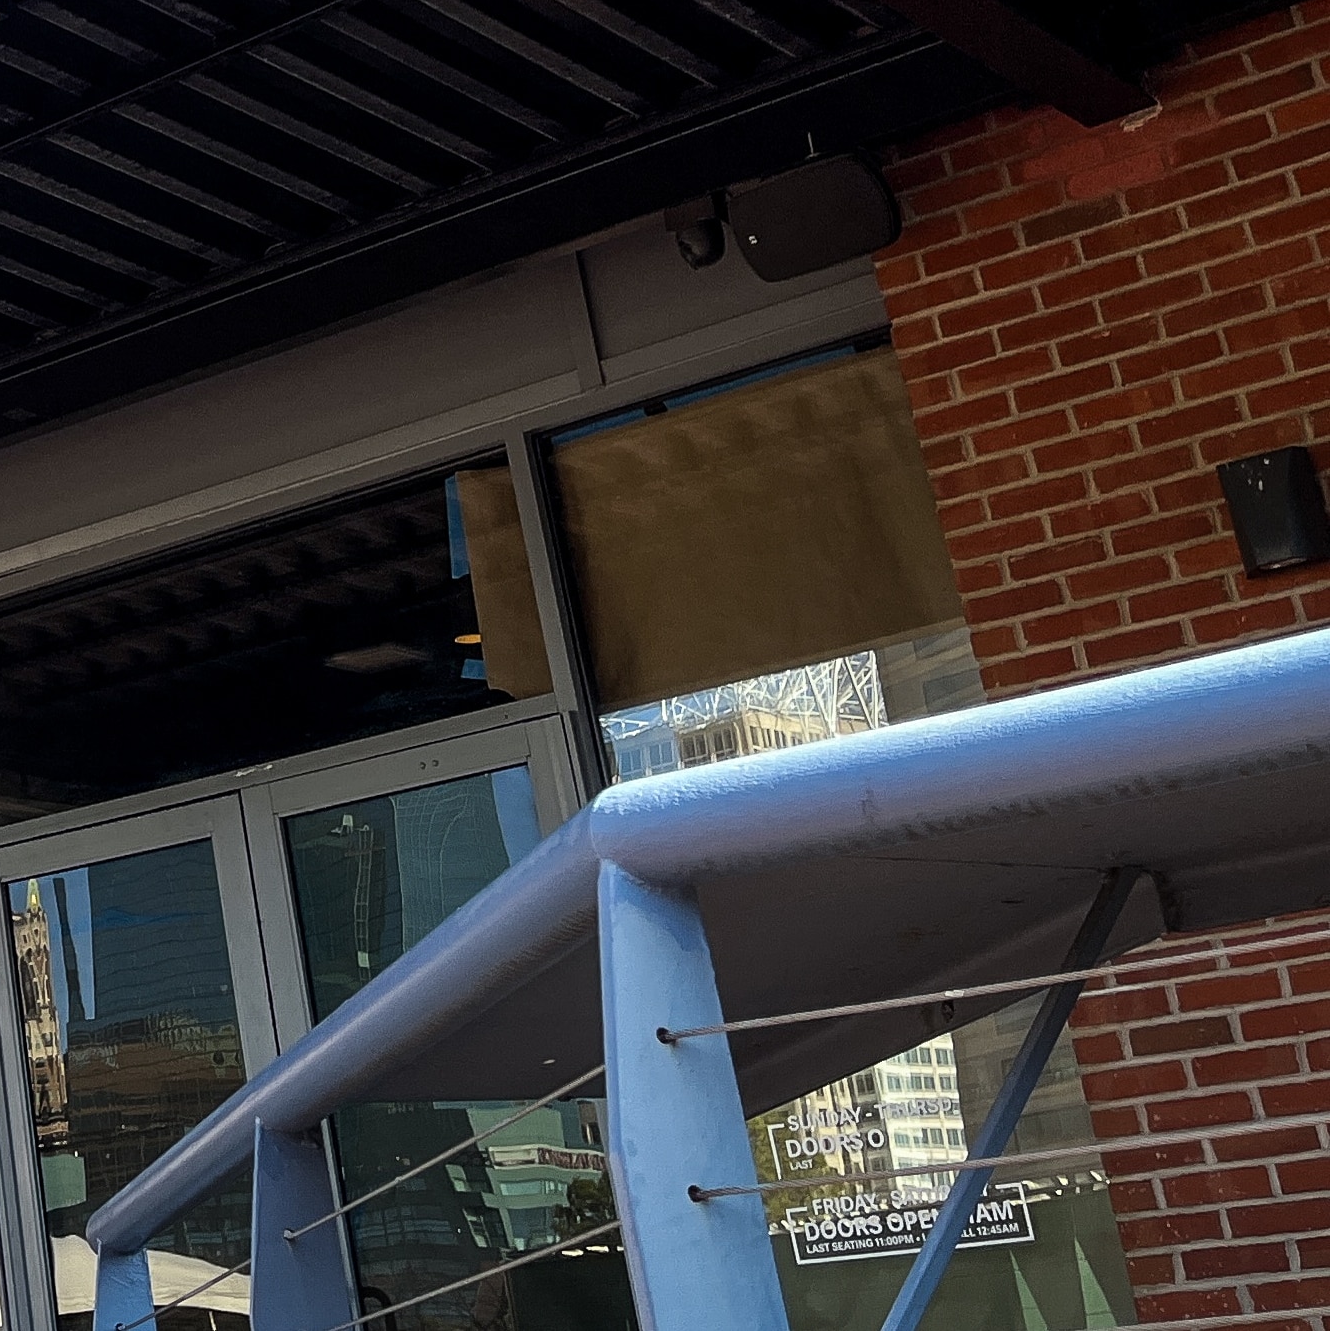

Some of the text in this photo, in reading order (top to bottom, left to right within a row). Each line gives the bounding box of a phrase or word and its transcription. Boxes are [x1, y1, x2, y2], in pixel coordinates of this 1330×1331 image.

[787, 1106, 861, 1132] SUNDAY
[785, 1133, 864, 1158] DOORS
[790, 1159, 814, 1171] LAST
[812, 1193, 879, 1216] FRIDAY
[804, 1215, 883, 1241] DOORS
[806, 1242, 830, 1254] LAST
[832, 1238, 874, 1252] SEATING
[874, 1234, 915, 1248] 11:00PM
[976, 1222, 1020, 1236] 12:45AM
